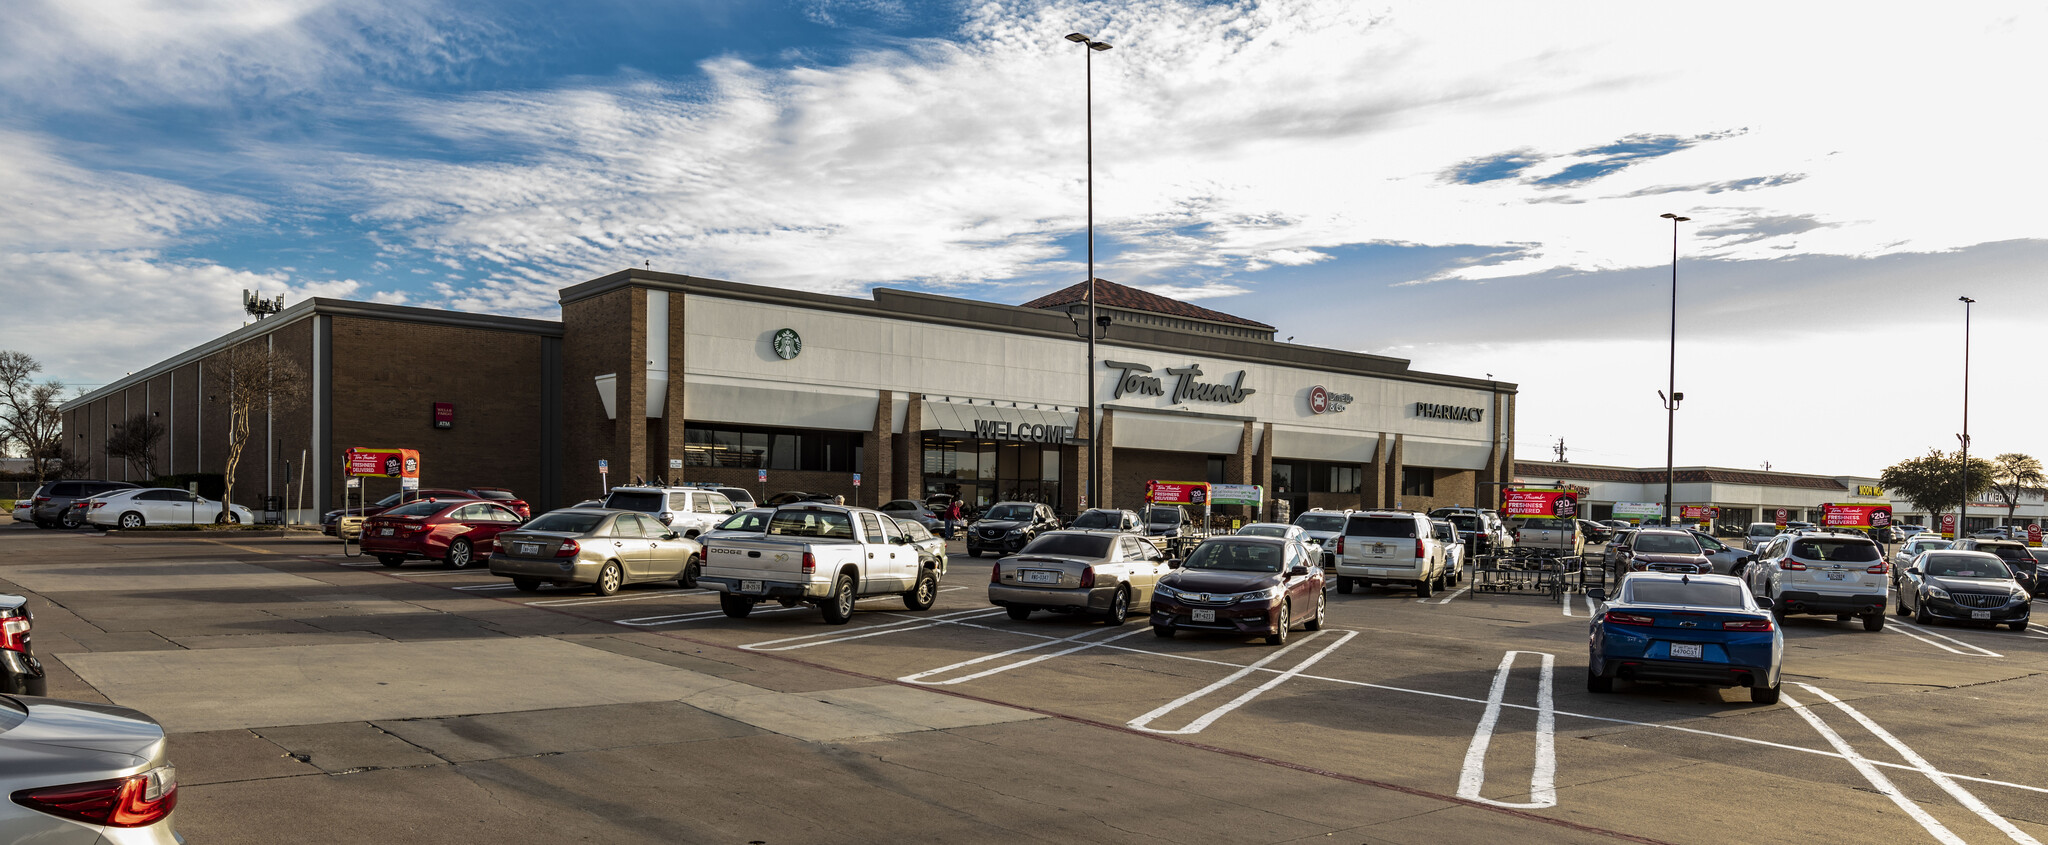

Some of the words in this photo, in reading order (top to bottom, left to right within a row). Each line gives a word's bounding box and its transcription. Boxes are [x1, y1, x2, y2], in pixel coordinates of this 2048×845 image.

[1105, 360, 1164, 399] Tom
[1166, 364, 1256, 405] Thumb
[1416, 402, 1485, 422] PHARMACY
[974, 420, 1074, 444] WELCOME
[1555, 500, 1570, 508] $20
[1871, 512, 1884, 520] $20
